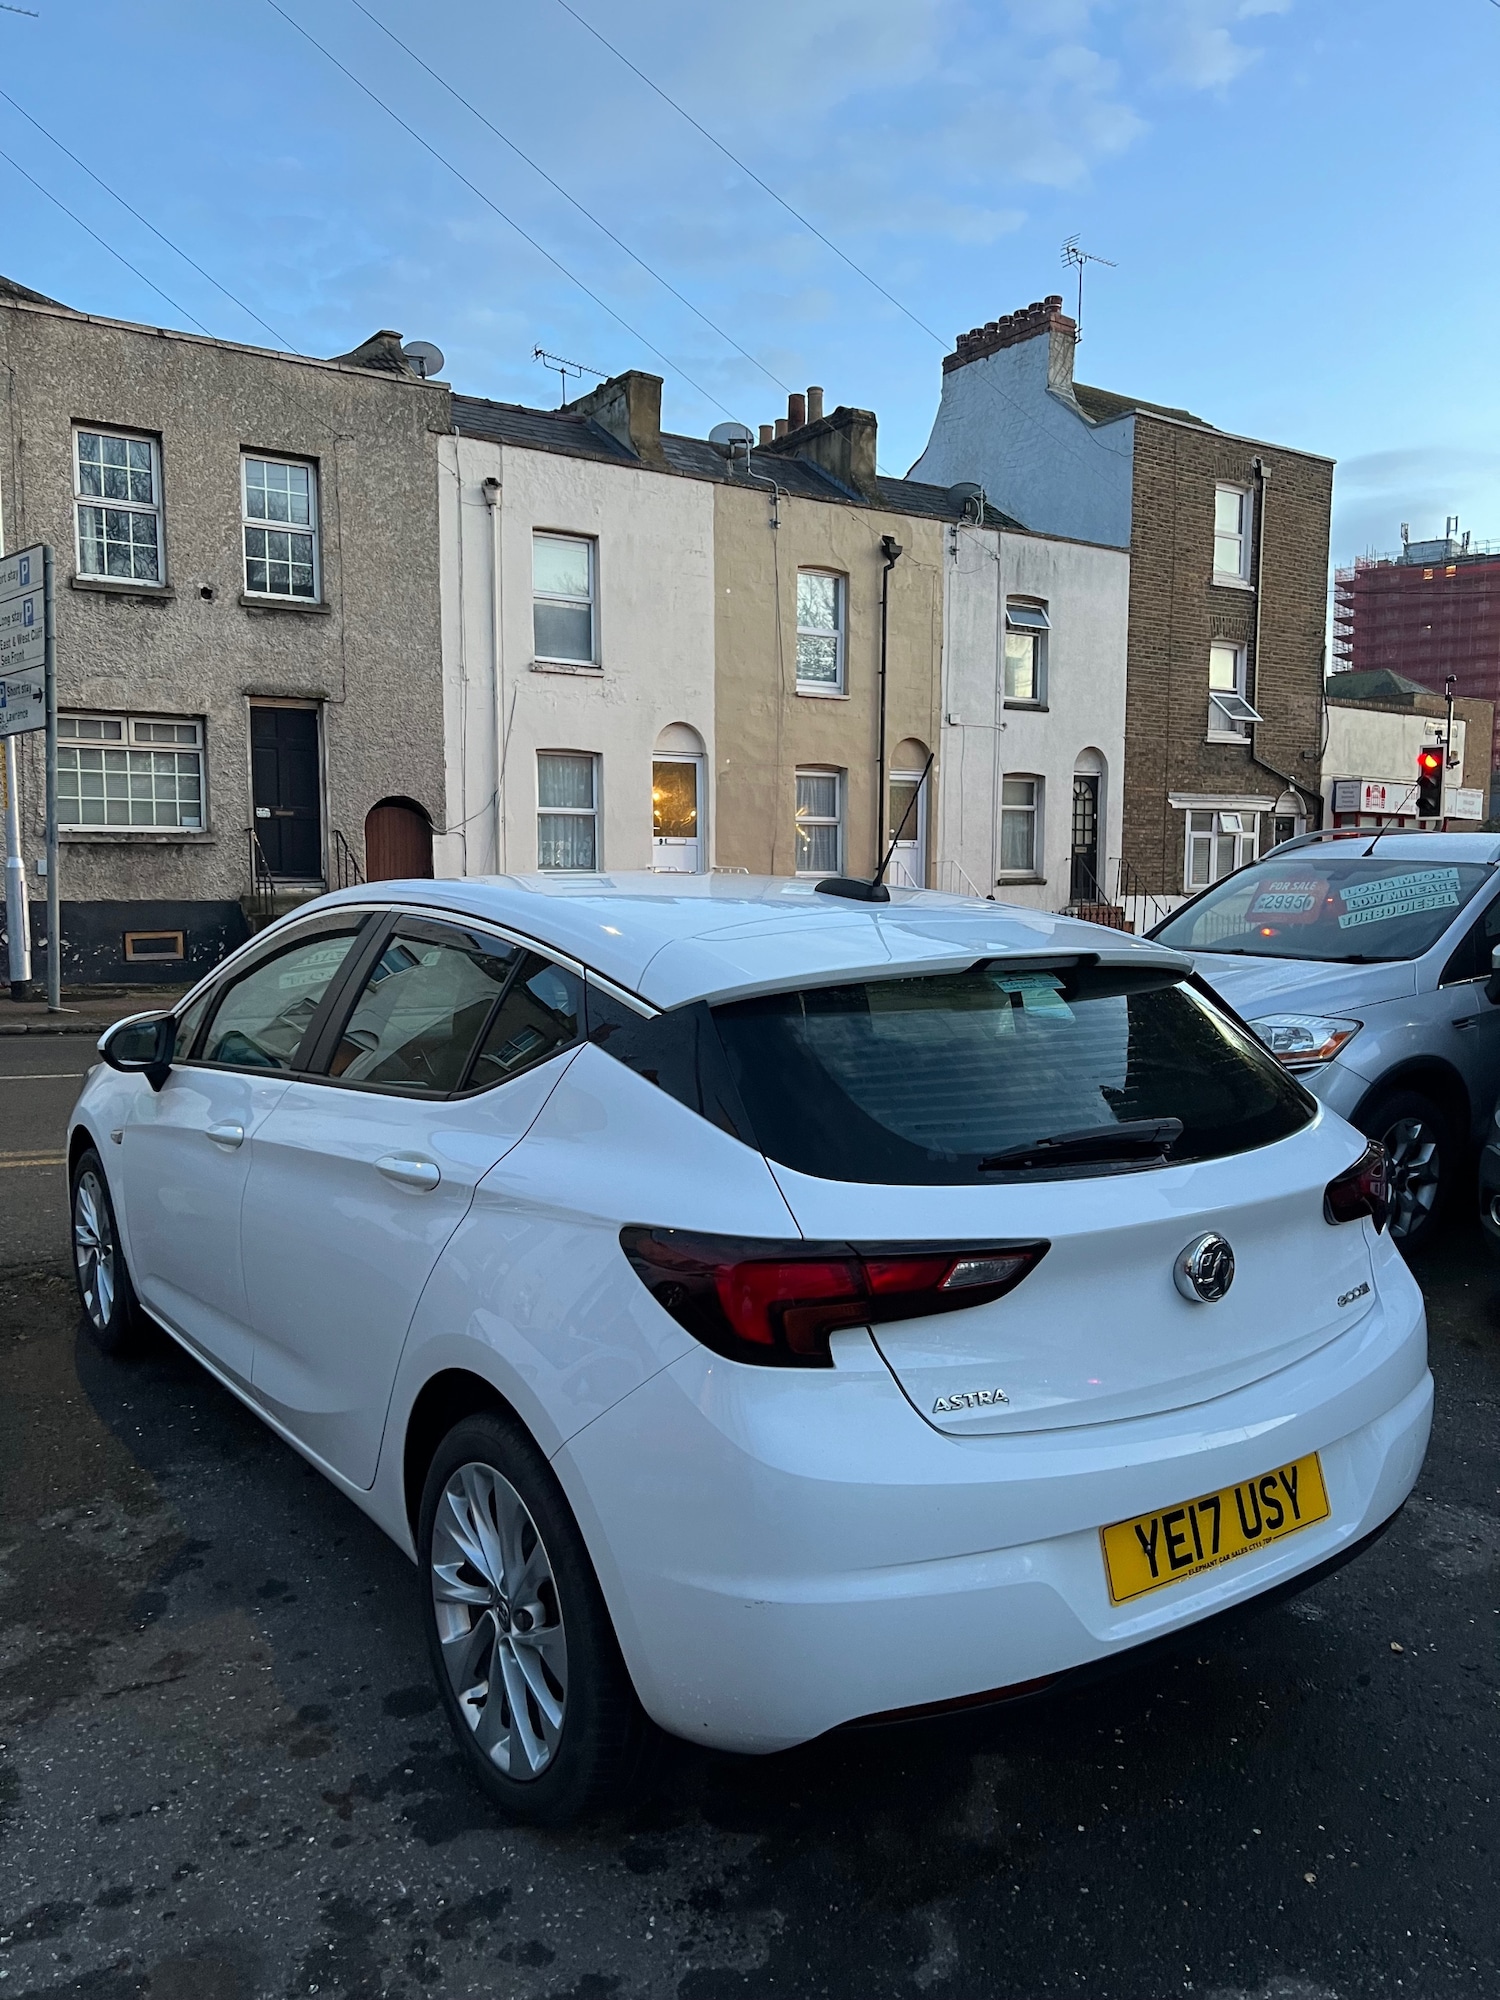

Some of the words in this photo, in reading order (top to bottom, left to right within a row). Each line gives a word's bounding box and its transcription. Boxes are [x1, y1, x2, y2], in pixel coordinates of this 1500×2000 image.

[1, 638, 11, 650] East
[17, 631, 30, 645] West
[31, 626, 43, 640] Cliff
[1, 655, 10, 666] Sea
[11, 648, 25, 662] Front
[7, 684, 20, 697] Short
[21, 683, 31, 695] stay
[6, 709, 28, 722] Lawrence
[1269, 881, 1291, 891] FOR
[1291, 881, 1318, 891] SALE
[1345, 881, 1394, 897] LONG
[1349, 894, 1384, 909] LOW
[1388, 881, 1458, 900] MILEAGE
[1342, 907, 1395, 926] TURBO
[1397, 893, 1456, 914] DIESEL
[932, 1388, 1010, 1414] ASTRA
[1134, 1496, 1220, 1579] YE17
[1234, 1465, 1301, 1540] USY
[1188, 1559, 1217, 1576] ELEPHANT
[1218, 1554, 1231, 1563] CAR
[1231, 1547, 1248, 1558] SALES
[1249, 1541, 1262, 1551] CT11
